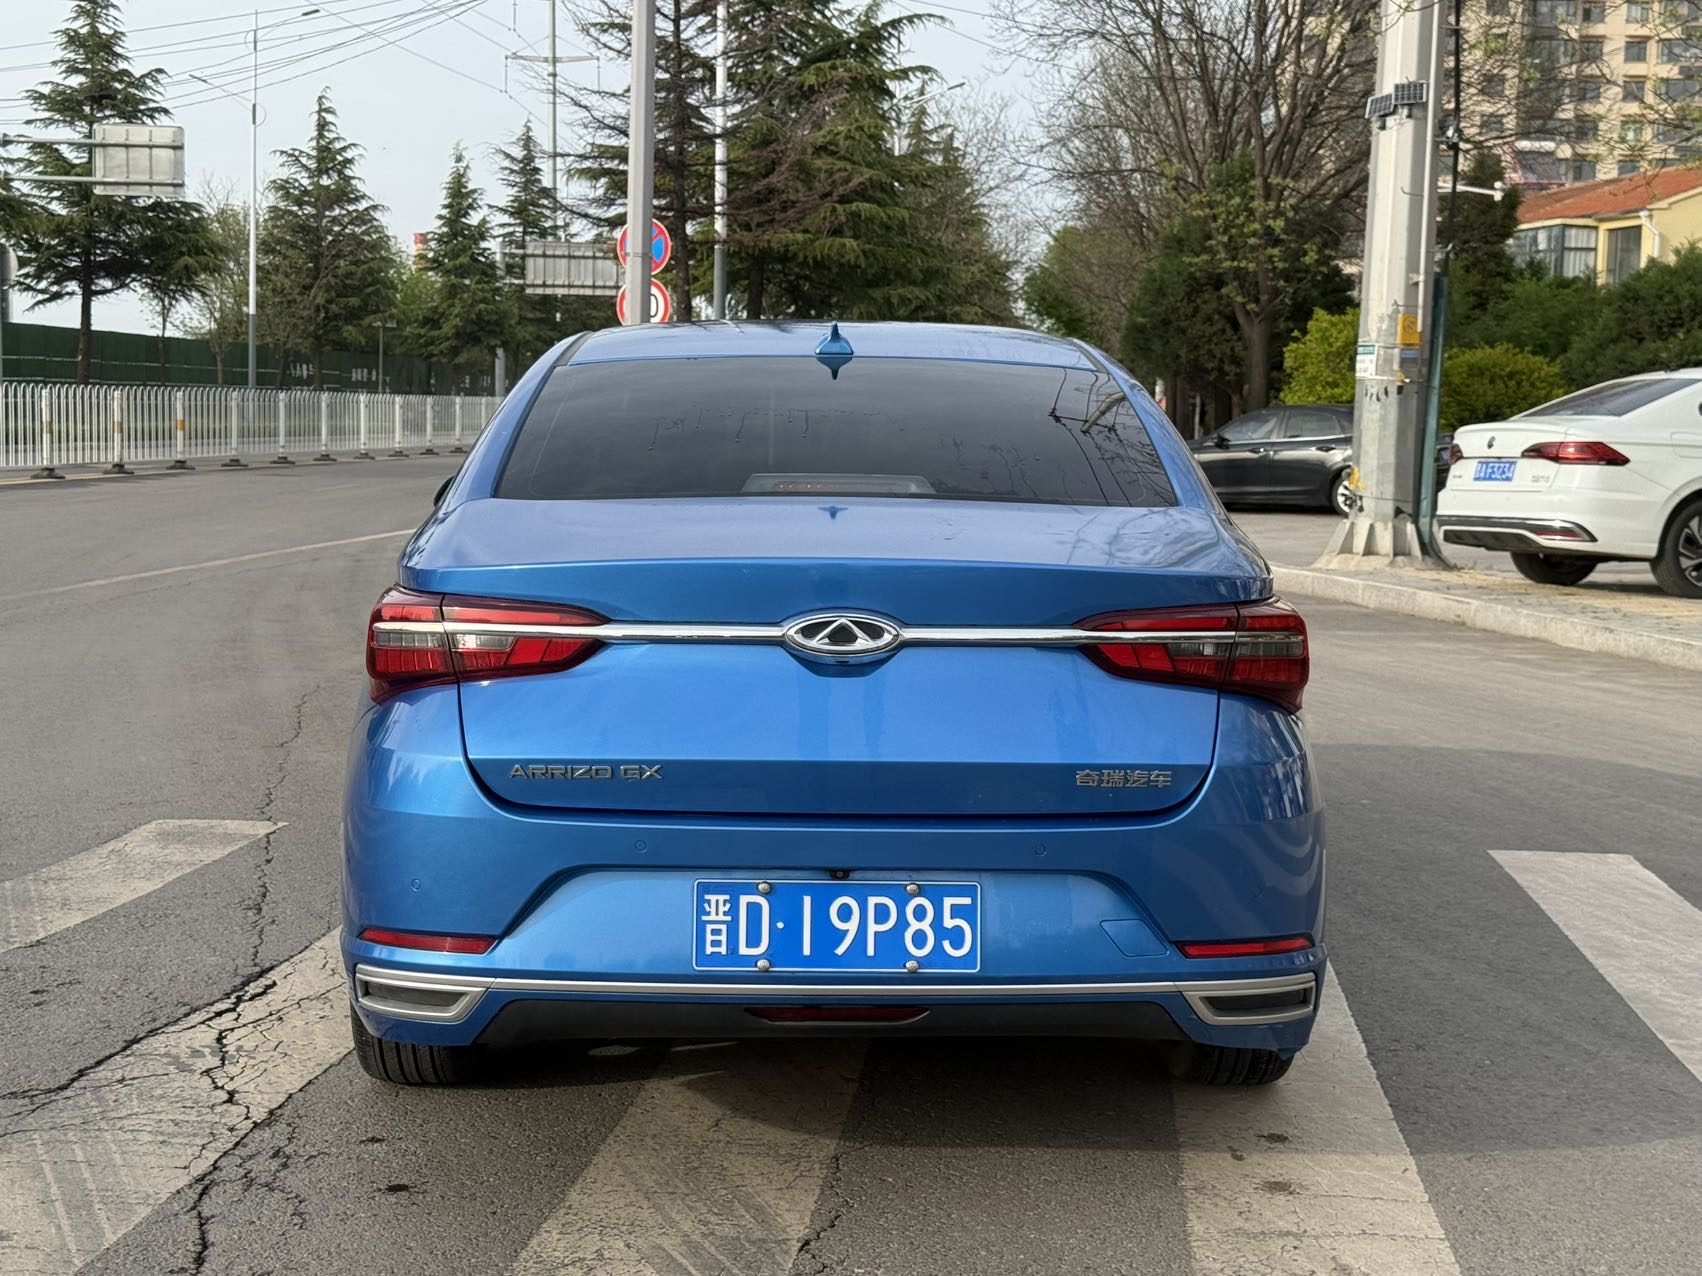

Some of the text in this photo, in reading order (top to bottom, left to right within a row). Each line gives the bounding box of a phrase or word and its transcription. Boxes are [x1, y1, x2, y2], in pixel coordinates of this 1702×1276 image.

[510, 764, 662, 780] ARRIZO GX
[1075, 769, 1172, 788] 奇瑞汽车
